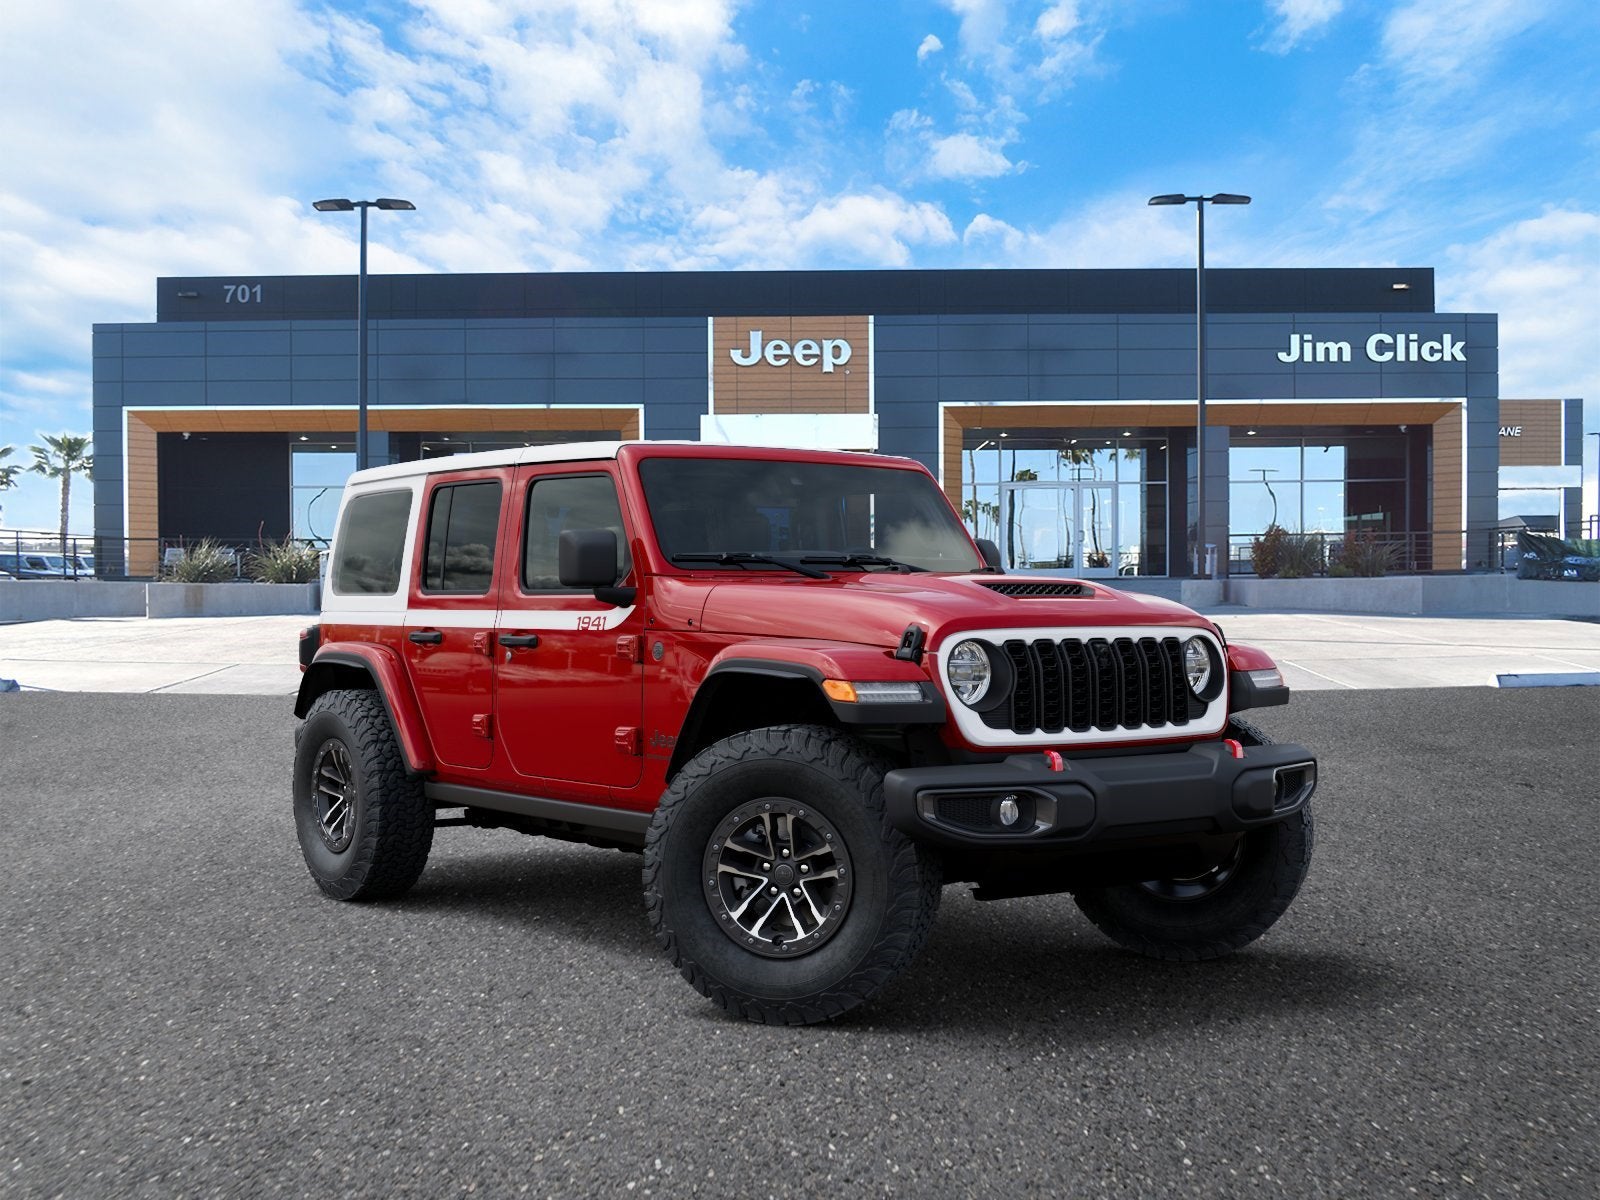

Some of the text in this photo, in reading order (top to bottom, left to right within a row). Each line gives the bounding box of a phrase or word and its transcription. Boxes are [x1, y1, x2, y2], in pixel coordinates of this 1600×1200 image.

[223, 284, 262, 303] 701
[730, 330, 852, 373] Jeep
[1277, 333, 1467, 363] Jim Click
[577, 615, 607, 631] 1941
[649, 729, 678, 748] Jee
